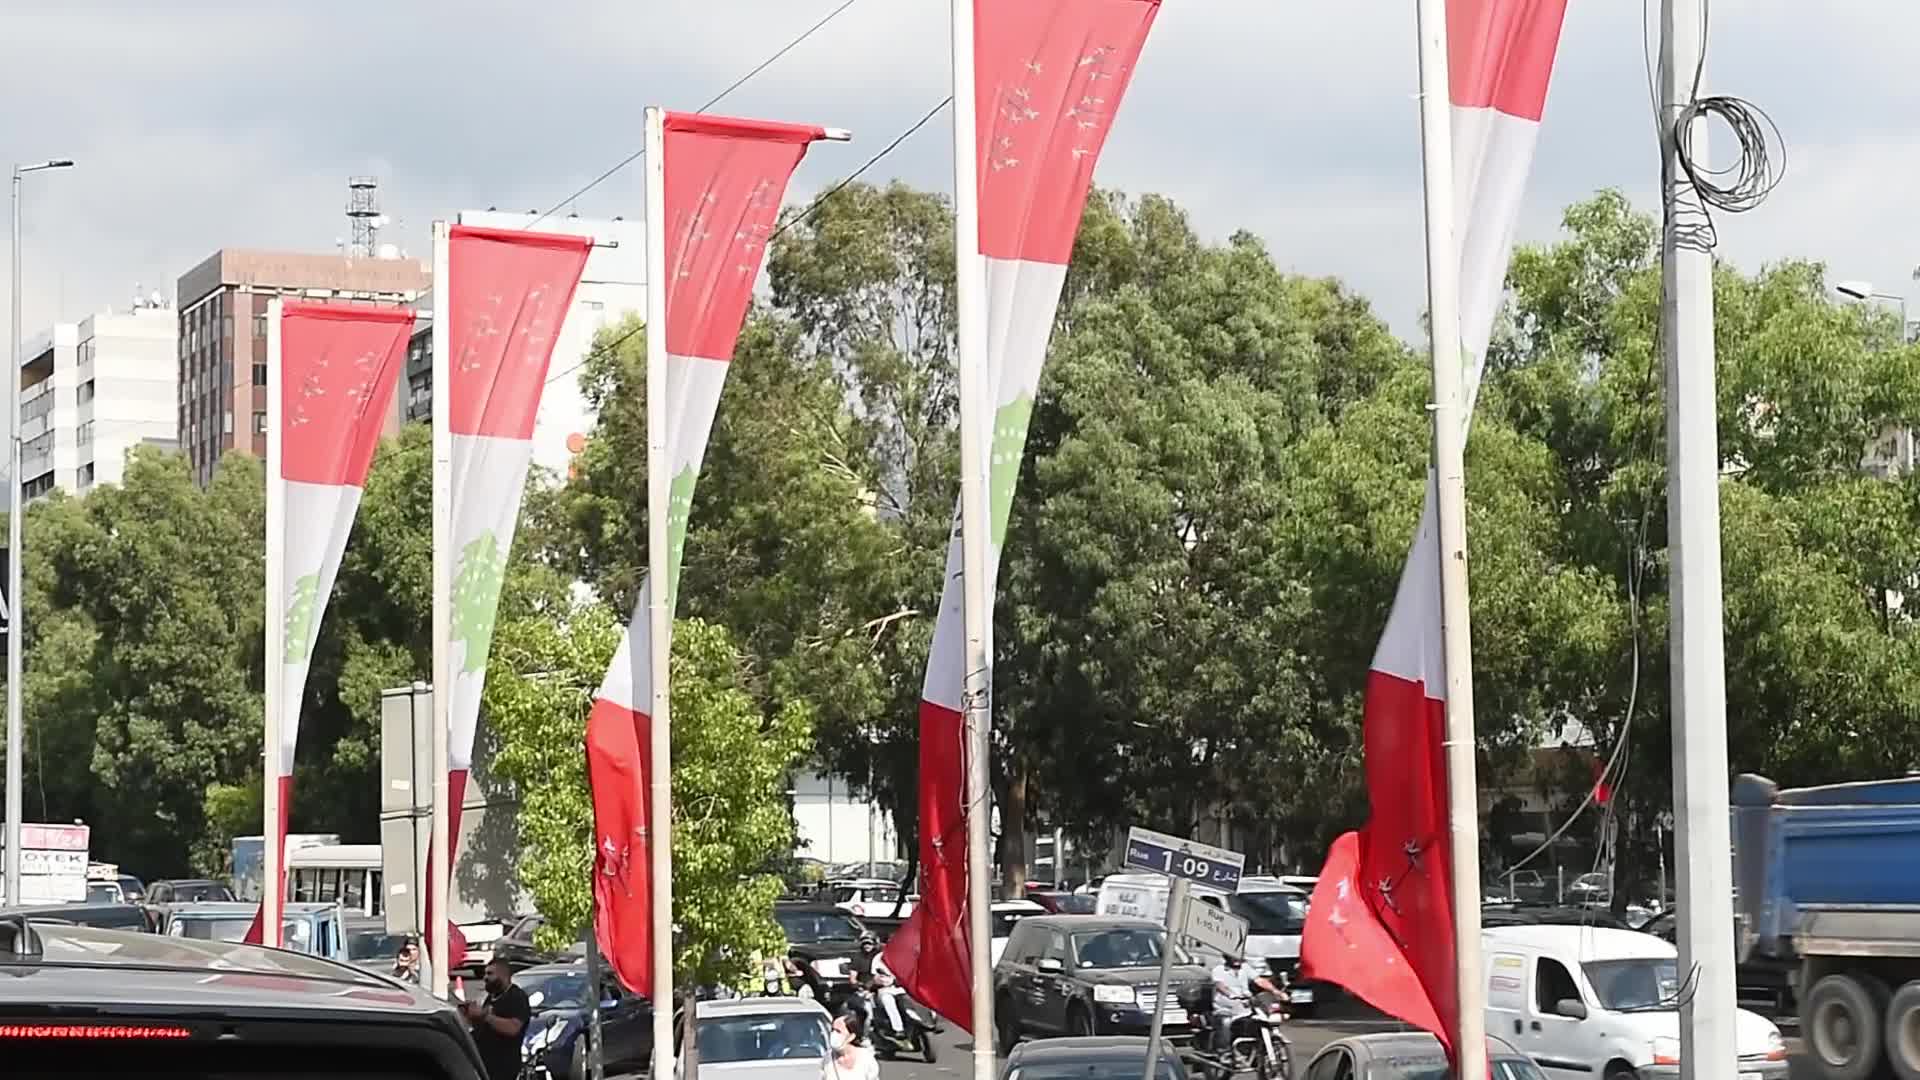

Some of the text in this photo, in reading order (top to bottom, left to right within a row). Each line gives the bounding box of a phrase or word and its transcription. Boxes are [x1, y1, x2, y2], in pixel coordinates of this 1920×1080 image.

[1129, 847, 1149, 860] Rue
[1162, 850, 1209, 878] 1-09
[1213, 869, 1238, 882] شارع
[1208, 909, 1224, 922] Rue
